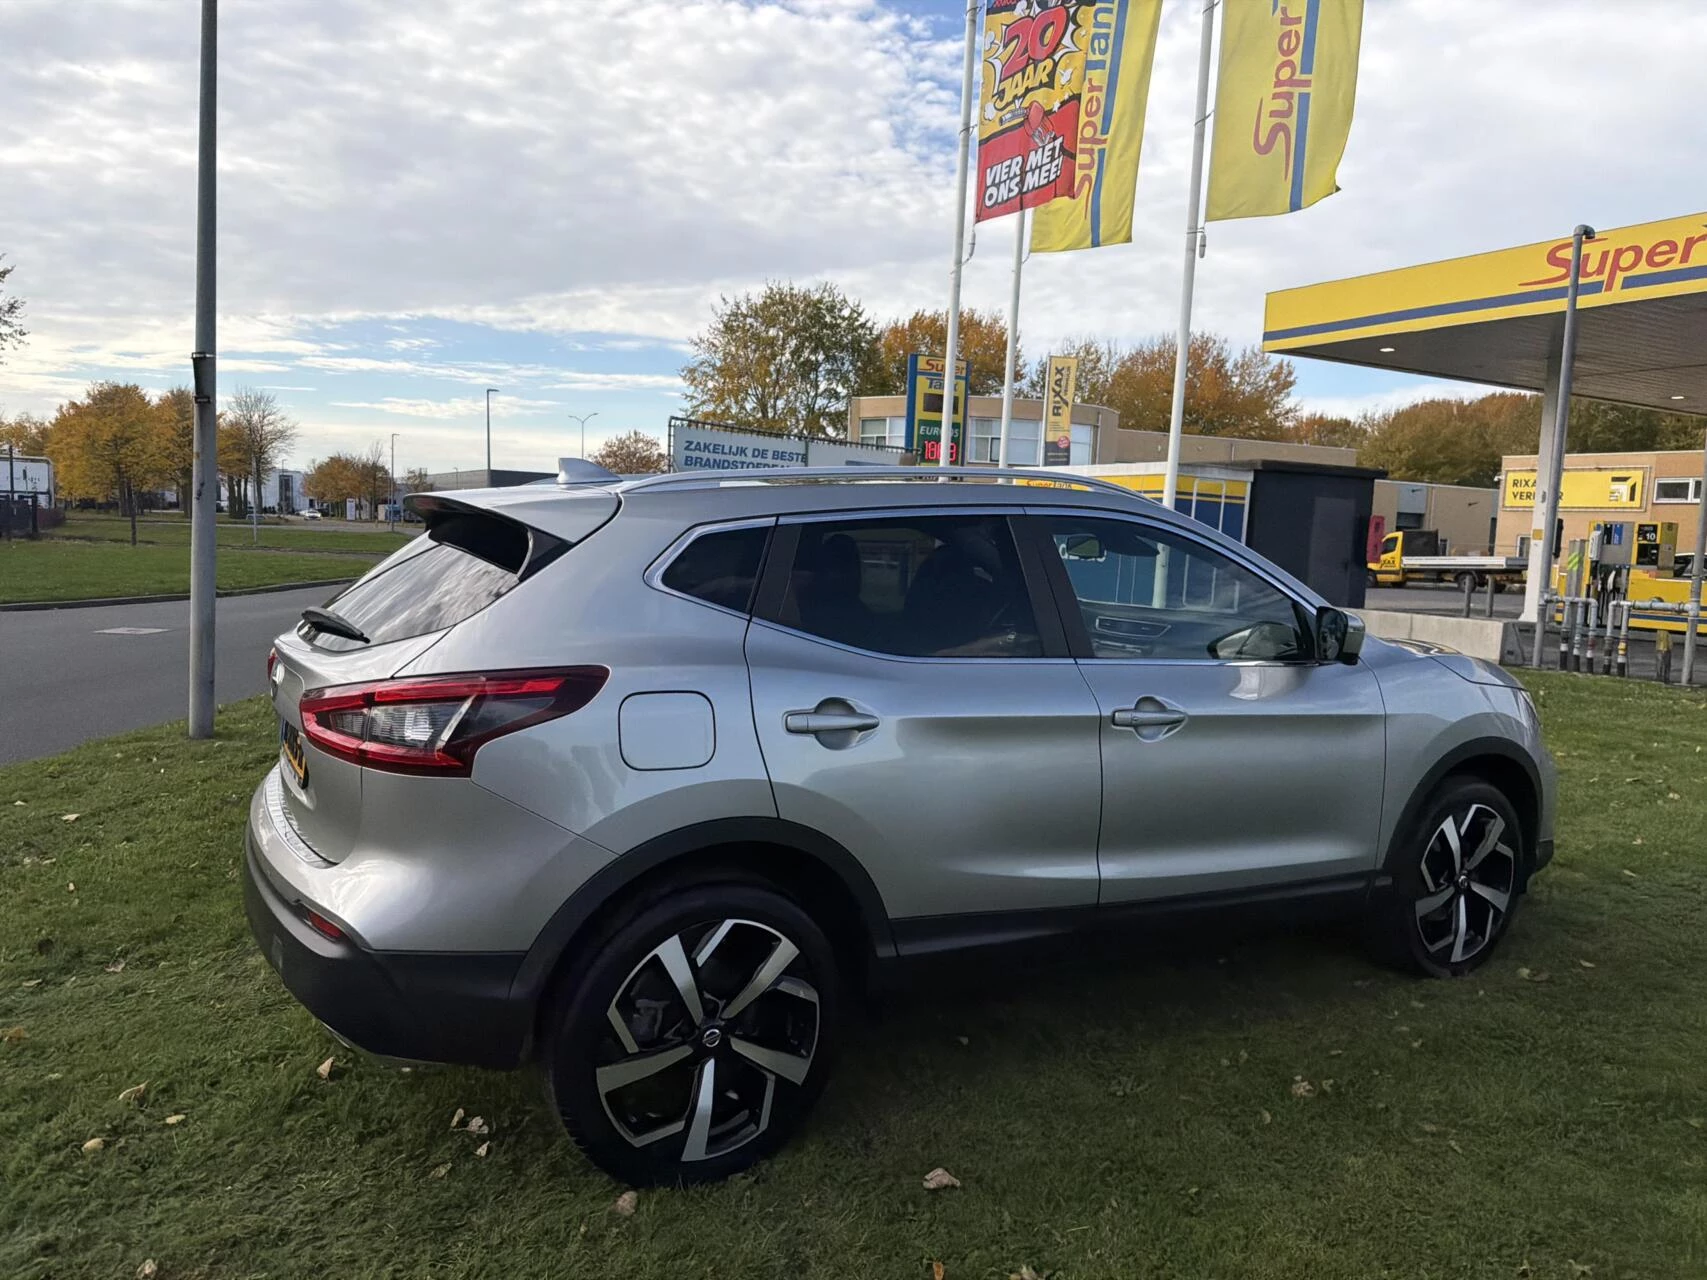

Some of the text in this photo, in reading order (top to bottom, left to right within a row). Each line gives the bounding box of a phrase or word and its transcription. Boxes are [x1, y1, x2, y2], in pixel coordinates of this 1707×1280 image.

[1002, 5, 1068, 80] 20
[995, 58, 1054, 110] JAAR
[1253, 5, 1312, 182] Super
[1074, 0, 1114, 220] Super Tan
[985, 154, 1064, 207] ONS MEE!
[986, 136, 1064, 186] VIER MET
[1518, 233, 1707, 292] Super
[919, 359, 965, 378] Suer
[1051, 366, 1069, 416] RIXAX
[684, 440, 807, 464] ZAKELIJK DE BESTE
[919, 425, 942, 436] EUR
[1512, 478, 1537, 488] RIXA
